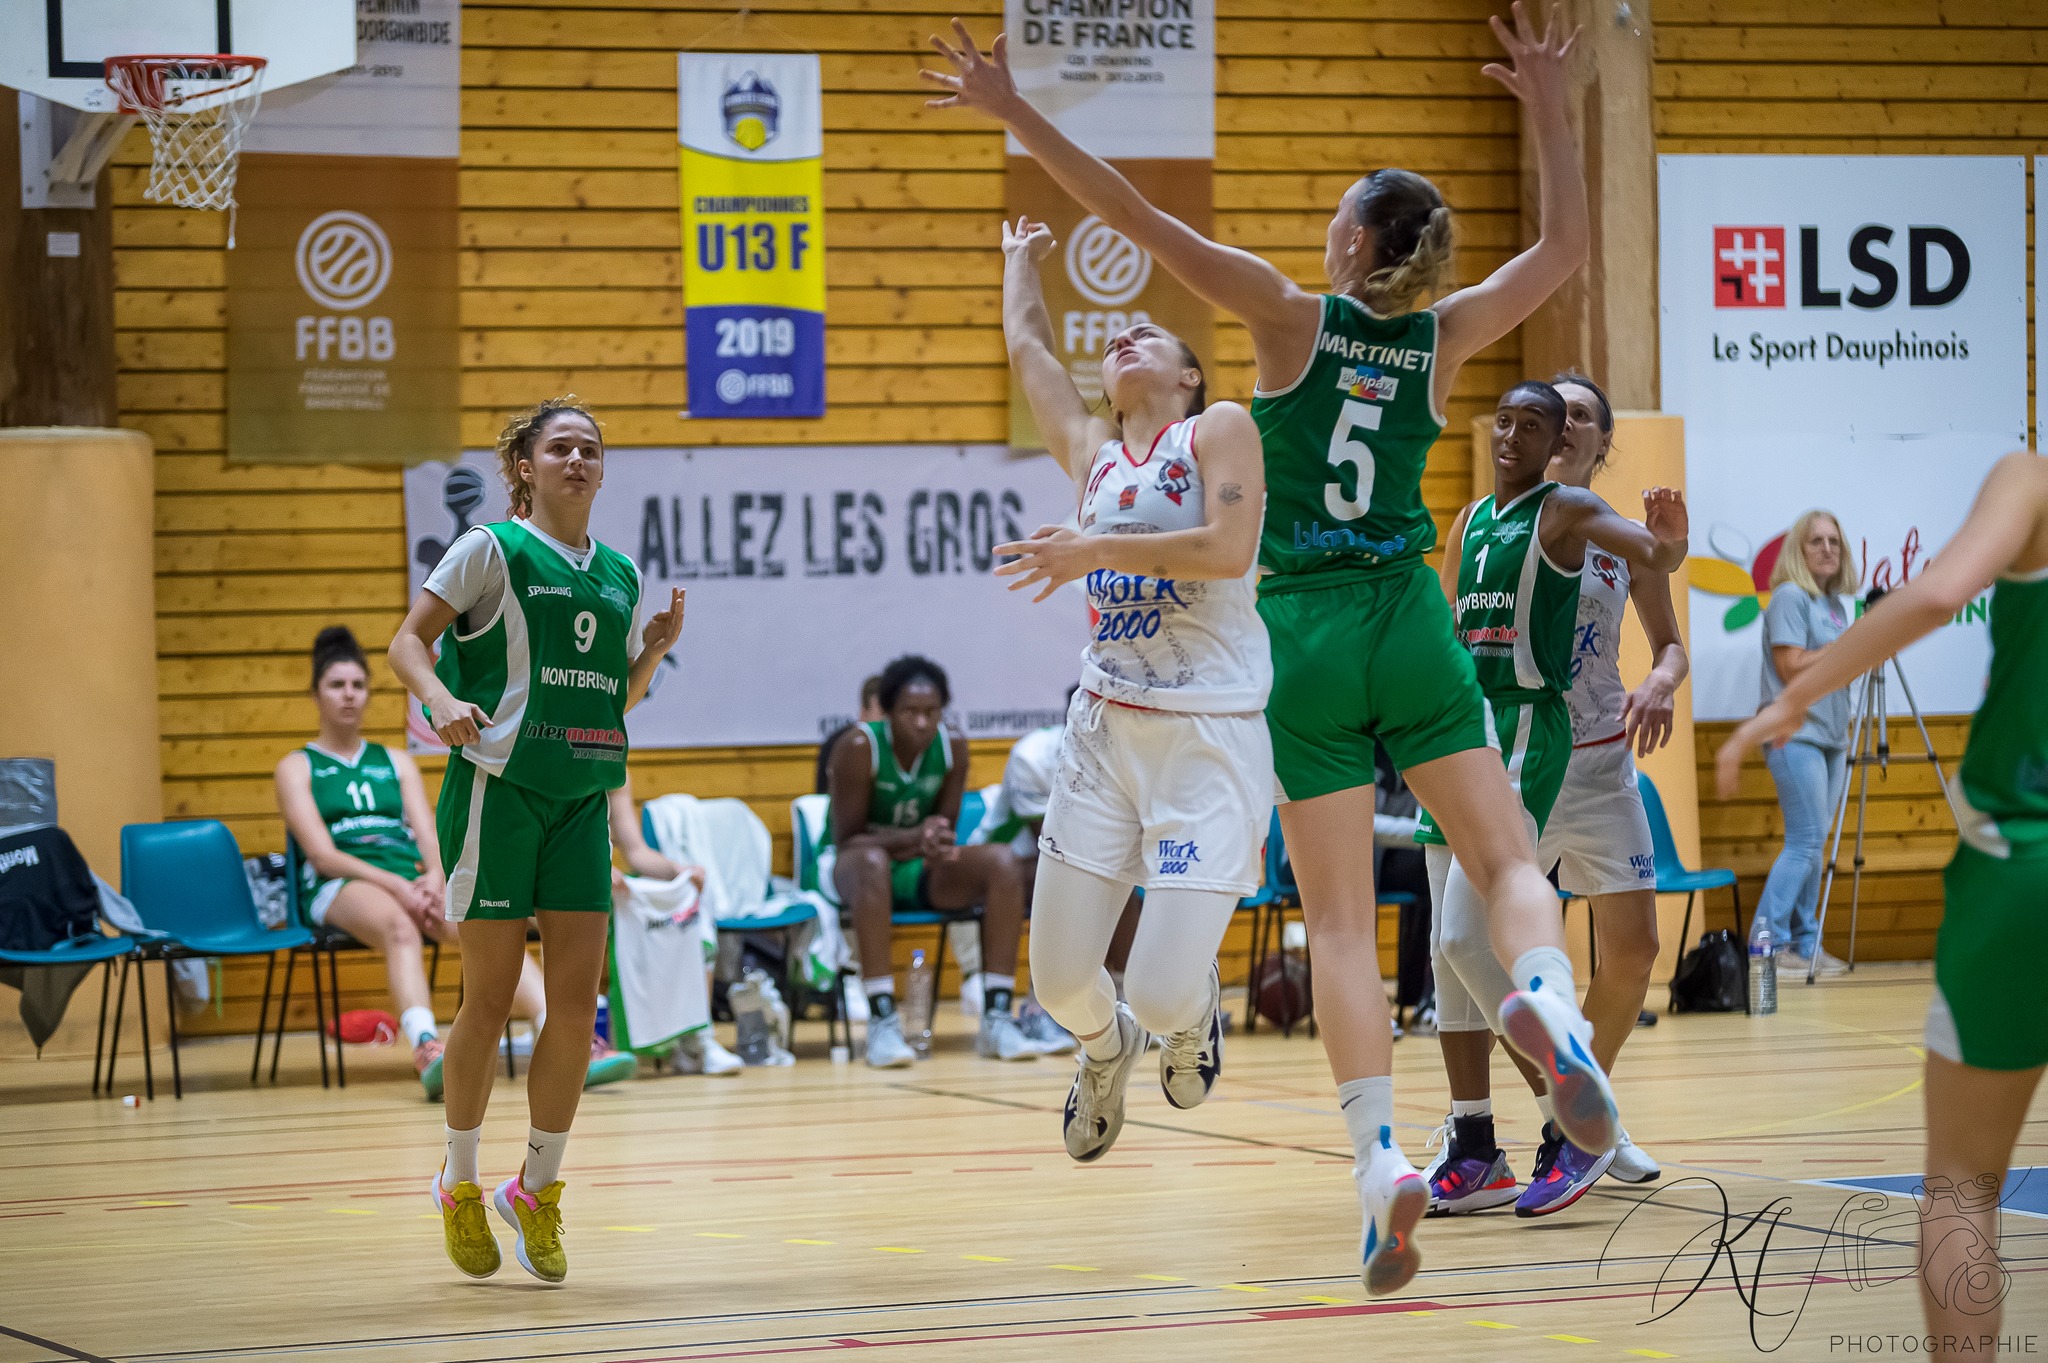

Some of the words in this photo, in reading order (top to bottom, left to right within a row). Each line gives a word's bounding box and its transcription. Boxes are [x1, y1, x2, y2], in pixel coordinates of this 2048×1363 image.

[1023, 20, 1062, 45] DE
[1072, 22, 1195, 49] FRANCE
[697, 223, 774, 272] U13
[789, 223, 808, 270] F
[1800, 225, 1971, 308] LSD
[296, 316, 394, 361] FFBB
[715, 317, 794, 358] 2019
[1319, 330, 1432, 372] MARTINET
[1713, 332, 1739, 361] Le
[1750, 331, 1817, 369] Sport
[1826, 328, 1970, 369] Dauphinois
[1324, 399, 1383, 520] 5
[639, 493, 786, 580] ALLEZ
[802, 490, 886, 576] LES
[905, 489, 1025, 575] GROS
[1474, 544, 1490, 583] 1
[527, 586, 573, 598] SPALDING
[1086, 567, 1189, 609] Work
[574, 611, 597, 653] 9
[1097, 608, 1161, 641] 2000
[541, 666, 619, 696] MONTBRISON
[346, 780, 376, 811] 11
[1158, 840, 1200, 862] Work
[1159, 861, 1189, 874] 2000
[479, 899, 510, 908] SPALDING
